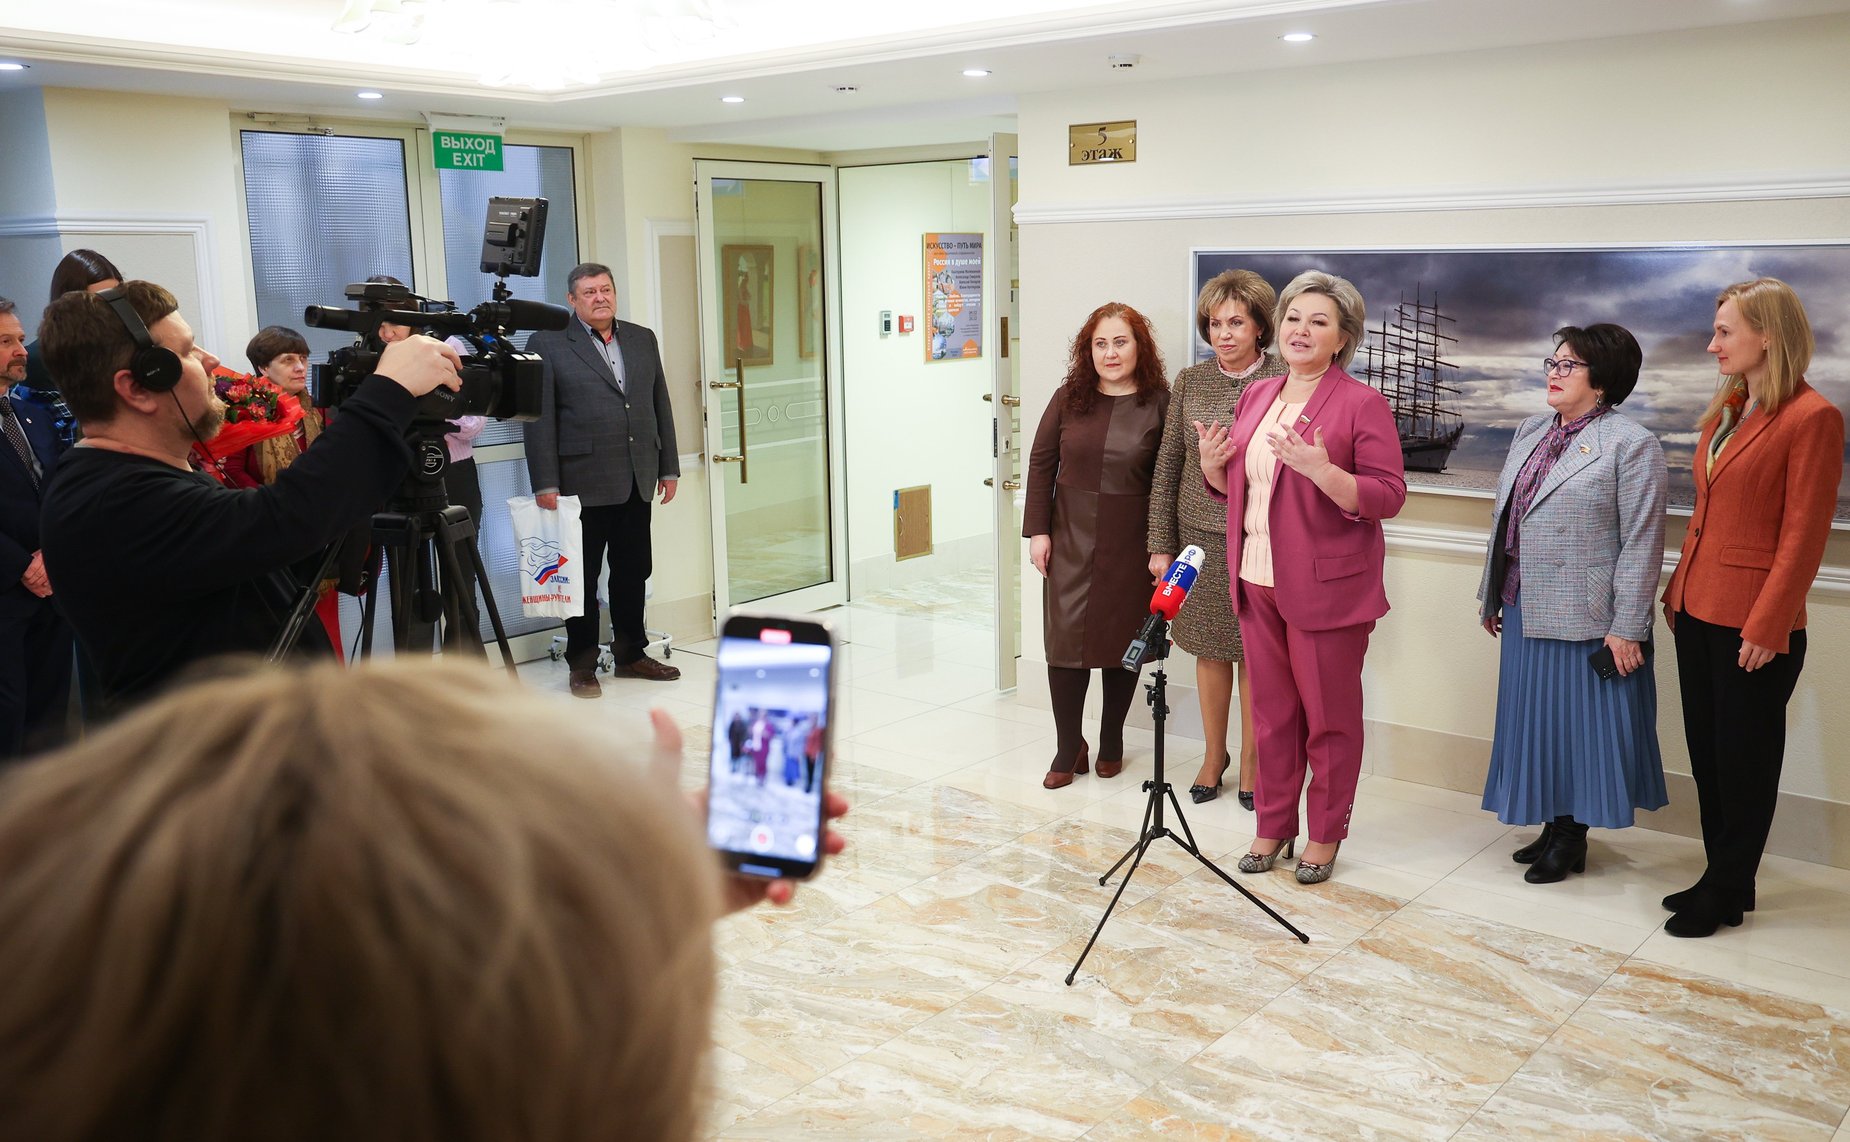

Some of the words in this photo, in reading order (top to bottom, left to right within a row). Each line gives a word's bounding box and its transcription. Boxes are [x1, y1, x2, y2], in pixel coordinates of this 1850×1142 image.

[1097, 126, 1107, 146] 5
[440, 136, 496, 155] ВЫХОД
[453, 152, 485, 167] EXIT
[1081, 148, 1123, 161] этаж
